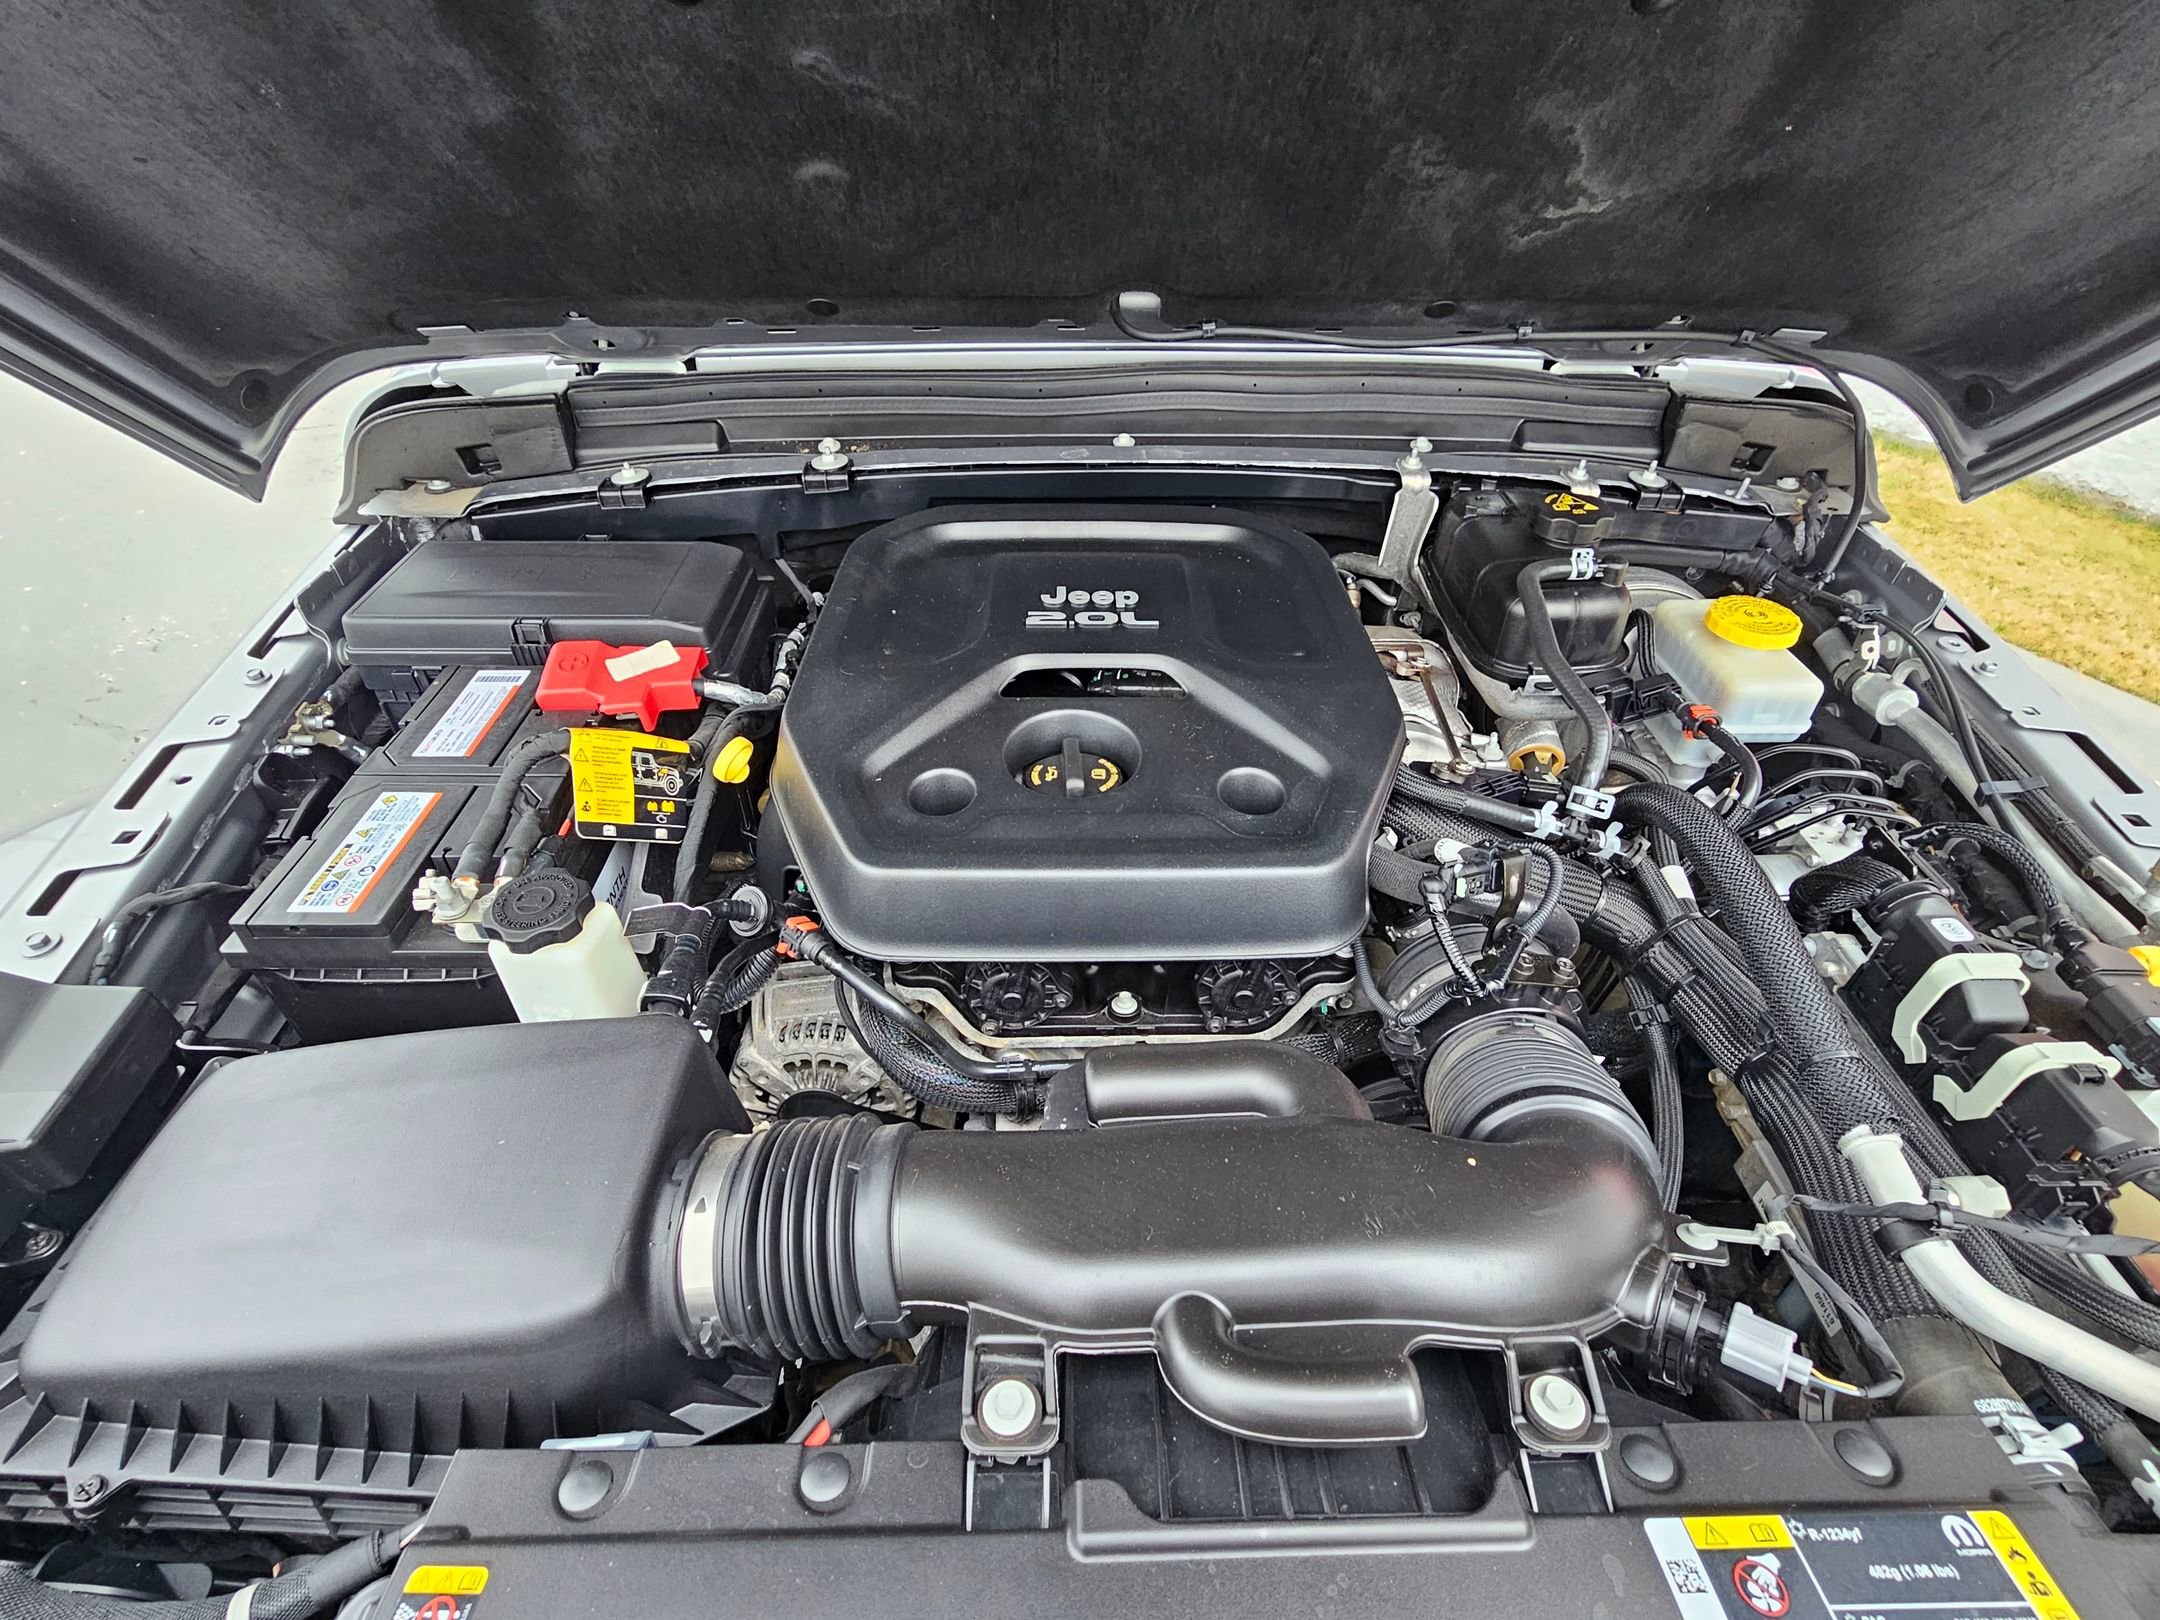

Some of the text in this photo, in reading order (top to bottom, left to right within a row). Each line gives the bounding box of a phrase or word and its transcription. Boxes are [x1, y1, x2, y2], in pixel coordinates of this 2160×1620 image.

[1040, 586, 1139, 609] Jeep
[1025, 611, 1160, 628] 2.0L
[533, 872, 575, 890] APPROVED
[502, 917, 549, 929] STEERING
[1806, 1527, 1863, 1544] R-1234yf
